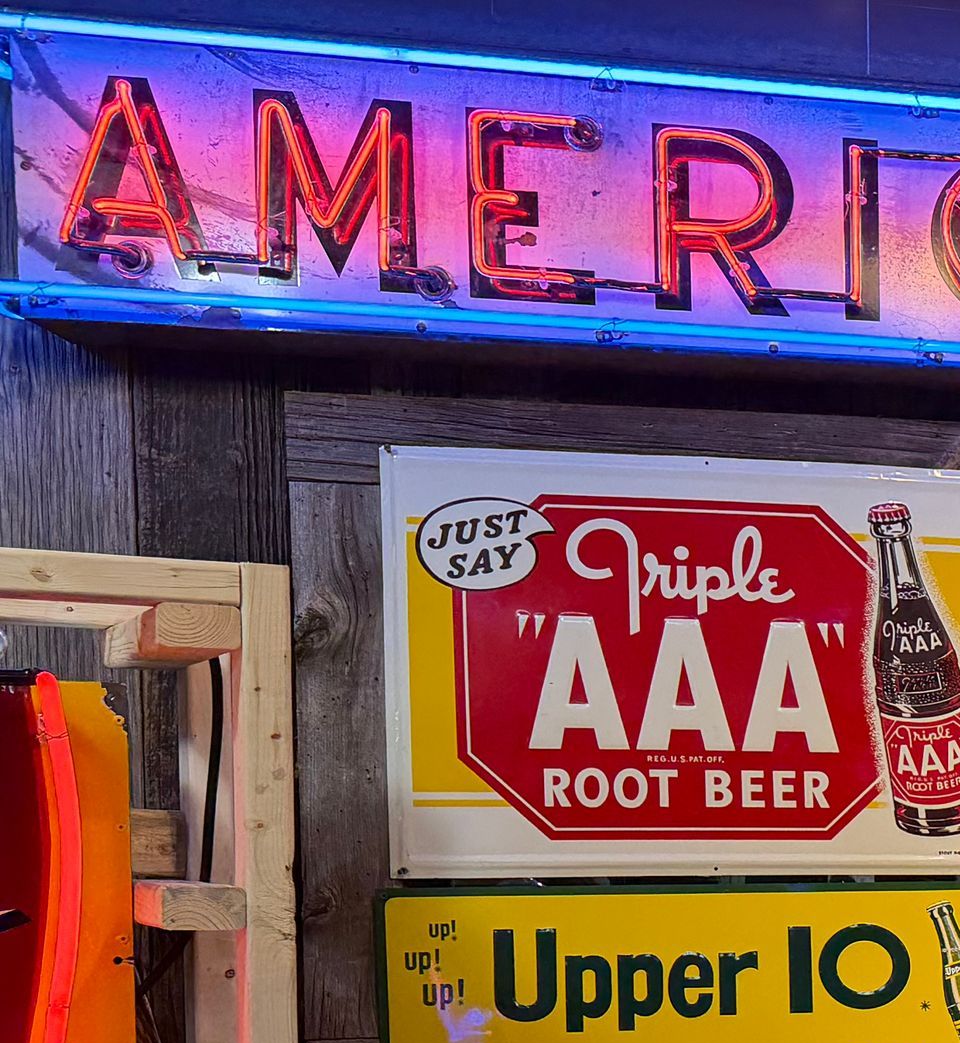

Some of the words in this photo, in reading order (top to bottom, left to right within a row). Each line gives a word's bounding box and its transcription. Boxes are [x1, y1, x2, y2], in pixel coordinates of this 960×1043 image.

[427, 509, 528, 550] JUST
[446, 541, 521, 579] SAY
[566, 517, 795, 636] Triple
[883, 617, 932, 651] Triple
[896, 725, 953, 748] Triple
[544, 768, 677, 808] ROOT
[705, 770, 830, 809] BEER
[906, 781, 933, 792] ROOT
[429, 919, 457, 941] up!
[405, 948, 441, 974] up!
[493, 927, 758, 1033] Upper
[788, 923, 911, 1014] 10
[423, 979, 464, 1010] up!
